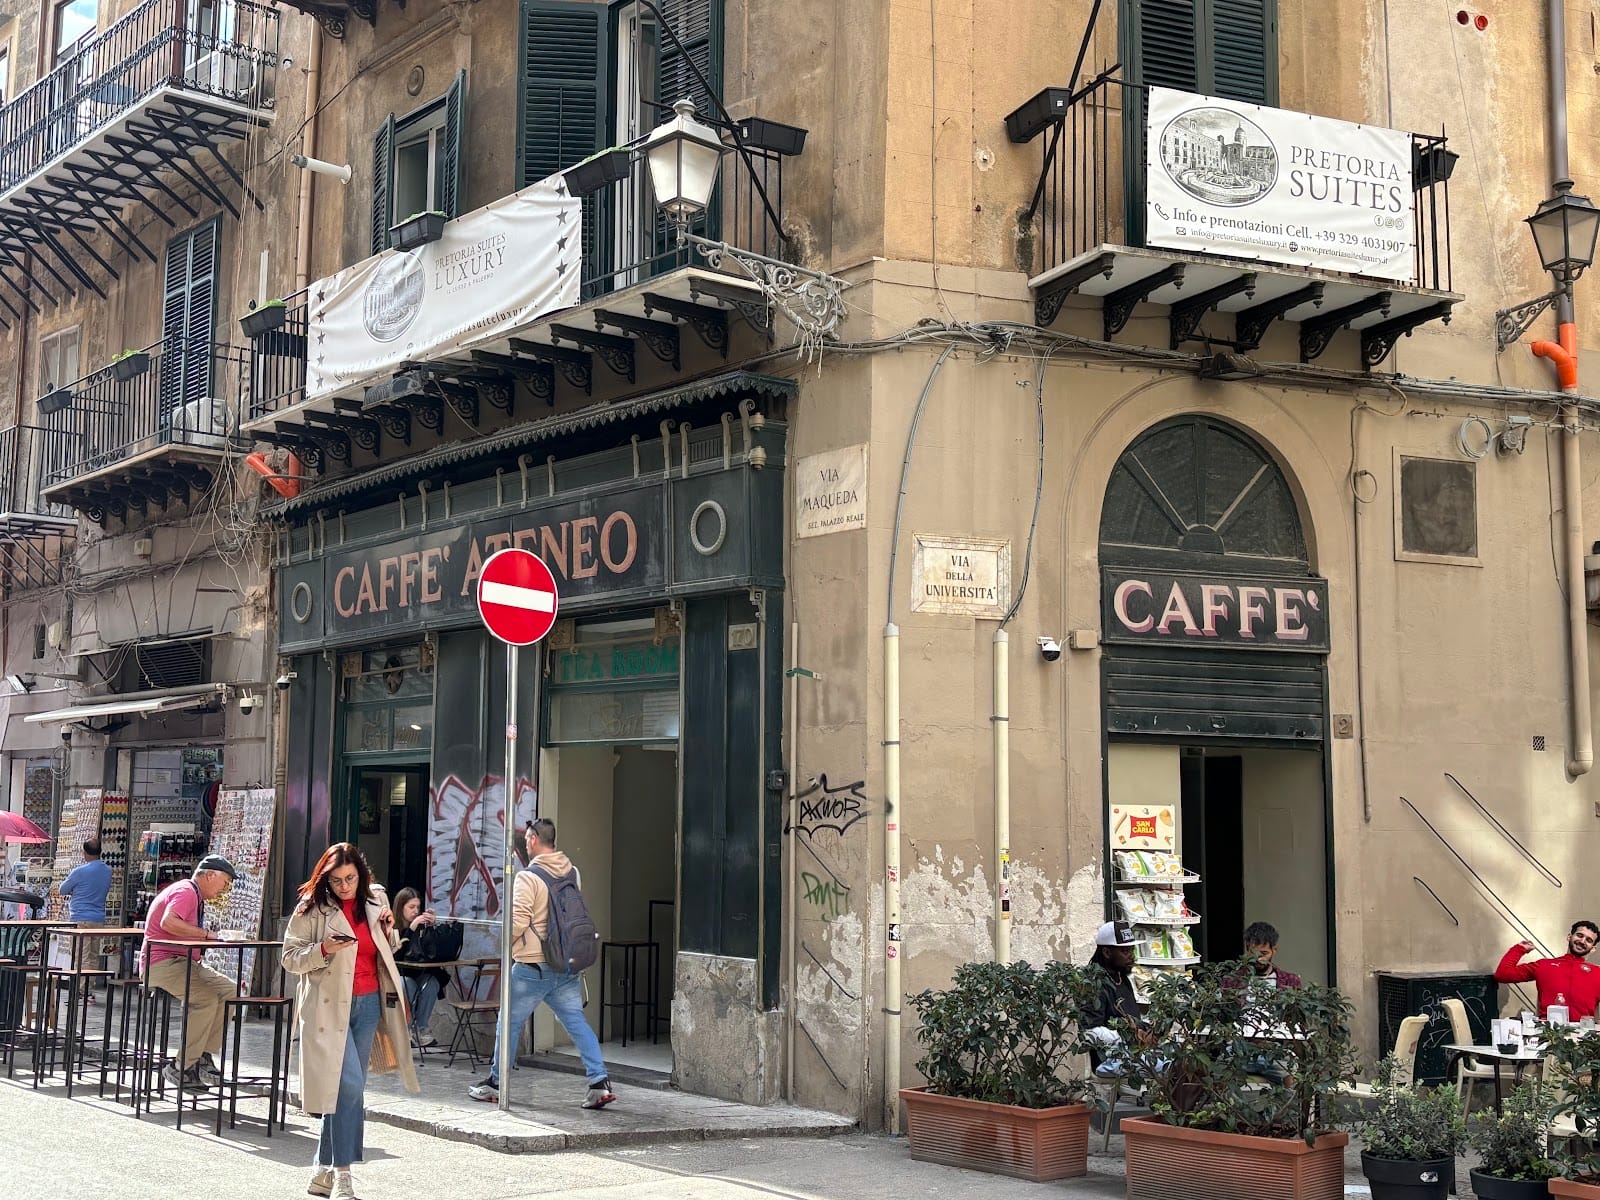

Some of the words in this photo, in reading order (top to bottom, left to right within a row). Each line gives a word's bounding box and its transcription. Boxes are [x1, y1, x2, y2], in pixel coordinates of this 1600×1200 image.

[1290, 145, 1401, 182] PRETORIA
[1290, 169, 1402, 213] SUITES
[1173, 207, 1198, 222] Info
[1200, 215, 1207, 224] e
[1210, 215, 1284, 236] prenotazioni
[1286, 224, 1313, 239] Cell.
[1315, 229, 1336, 242] +39
[1339, 232, 1359, 246] 329
[1361, 236, 1406, 253] 4031907
[435, 246, 475, 270] PRETORIA
[477, 232, 506, 253] SUITES
[435, 245, 507, 291] LUXURY
[820, 468, 839, 482] VIA
[803, 490, 858, 512] MAQUEDA
[945, 571, 973, 582] DELLA
[951, 556, 970, 567] VIA
[334, 544, 452, 618] CAFFE'
[1113, 579, 1321, 640] CAFFE'
[560, 653, 604, 681] TEA
[610, 646, 678, 677] ROOM
[1338, 718, 1349, 735] 2
[1132, 826, 1155, 834] CARLO
